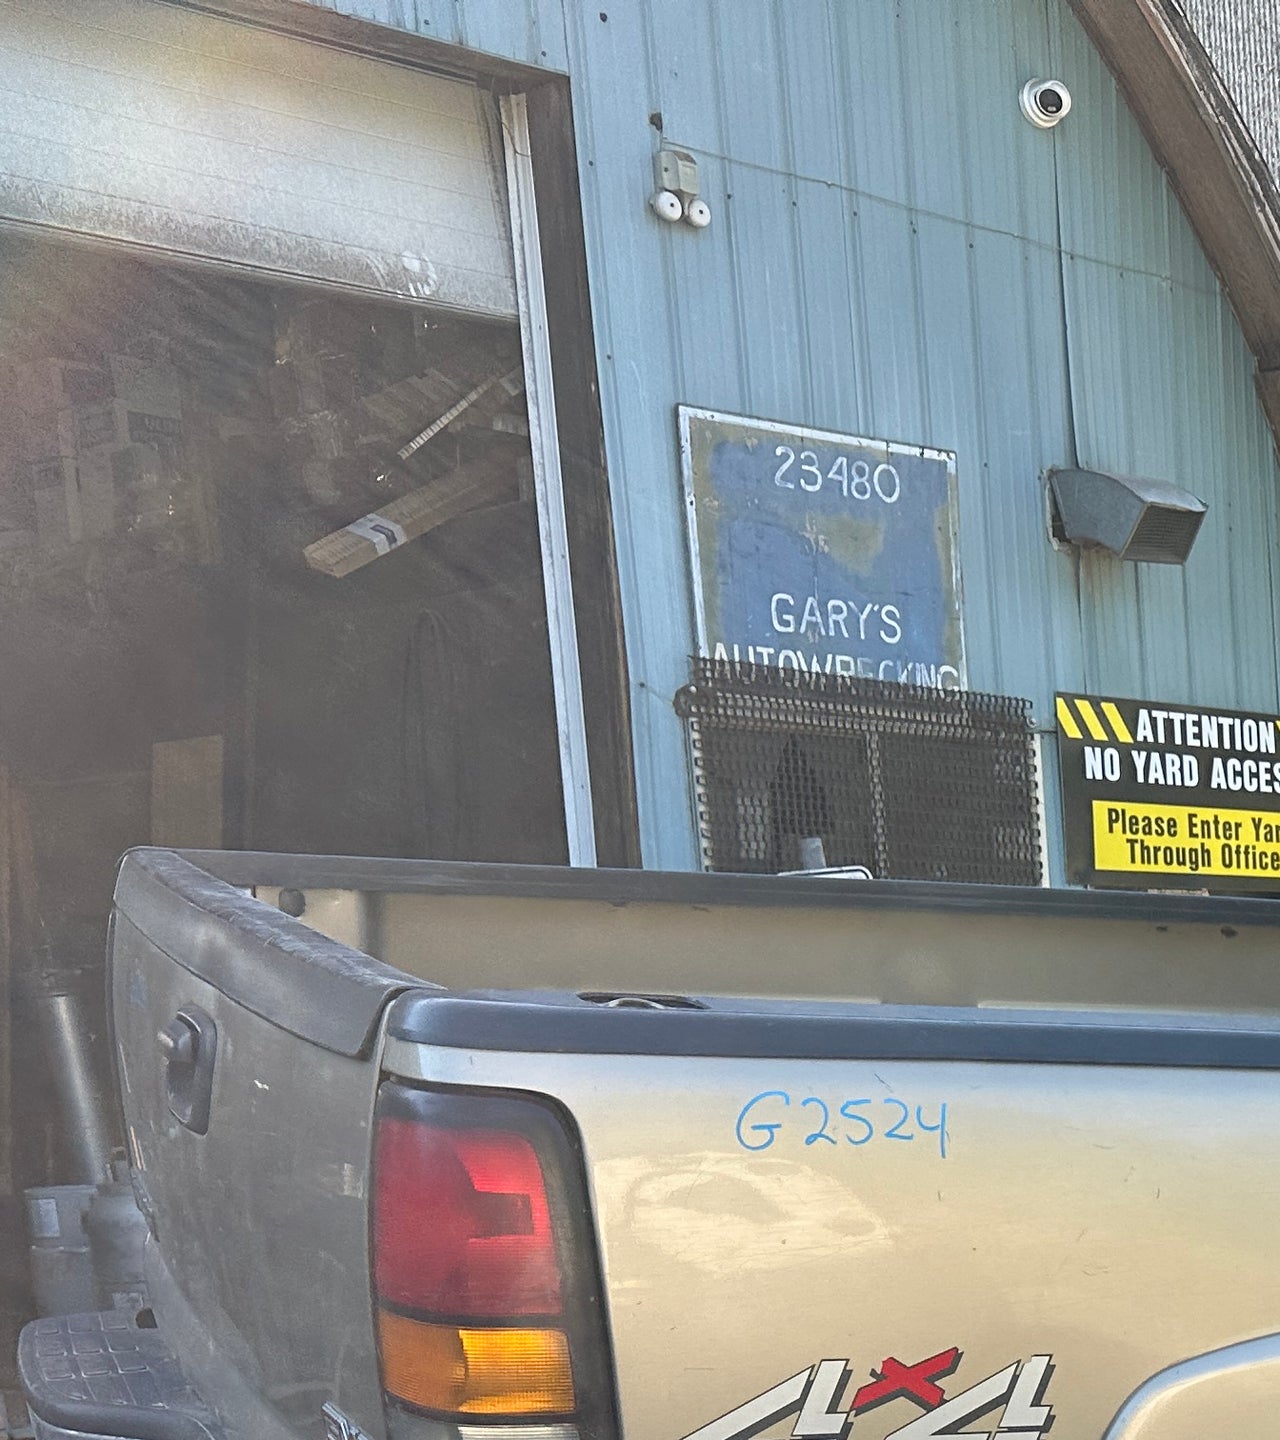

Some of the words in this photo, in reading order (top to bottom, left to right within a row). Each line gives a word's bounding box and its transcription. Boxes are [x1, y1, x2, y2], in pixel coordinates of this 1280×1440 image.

[774, 445, 901, 504] 23480
[770, 592, 902, 644] GARY'S
[1136, 708, 1276, 755] ATTENTION
[1084, 746, 1121, 782] NO
[1131, 750, 1199, 788] YARD
[1107, 808, 1178, 838] Please
[1187, 813, 1242, 842] Enter
[1126, 838, 1212, 872] Through
[1221, 842, 1280, 871] Office
[736, 1091, 948, 1159] G2524
